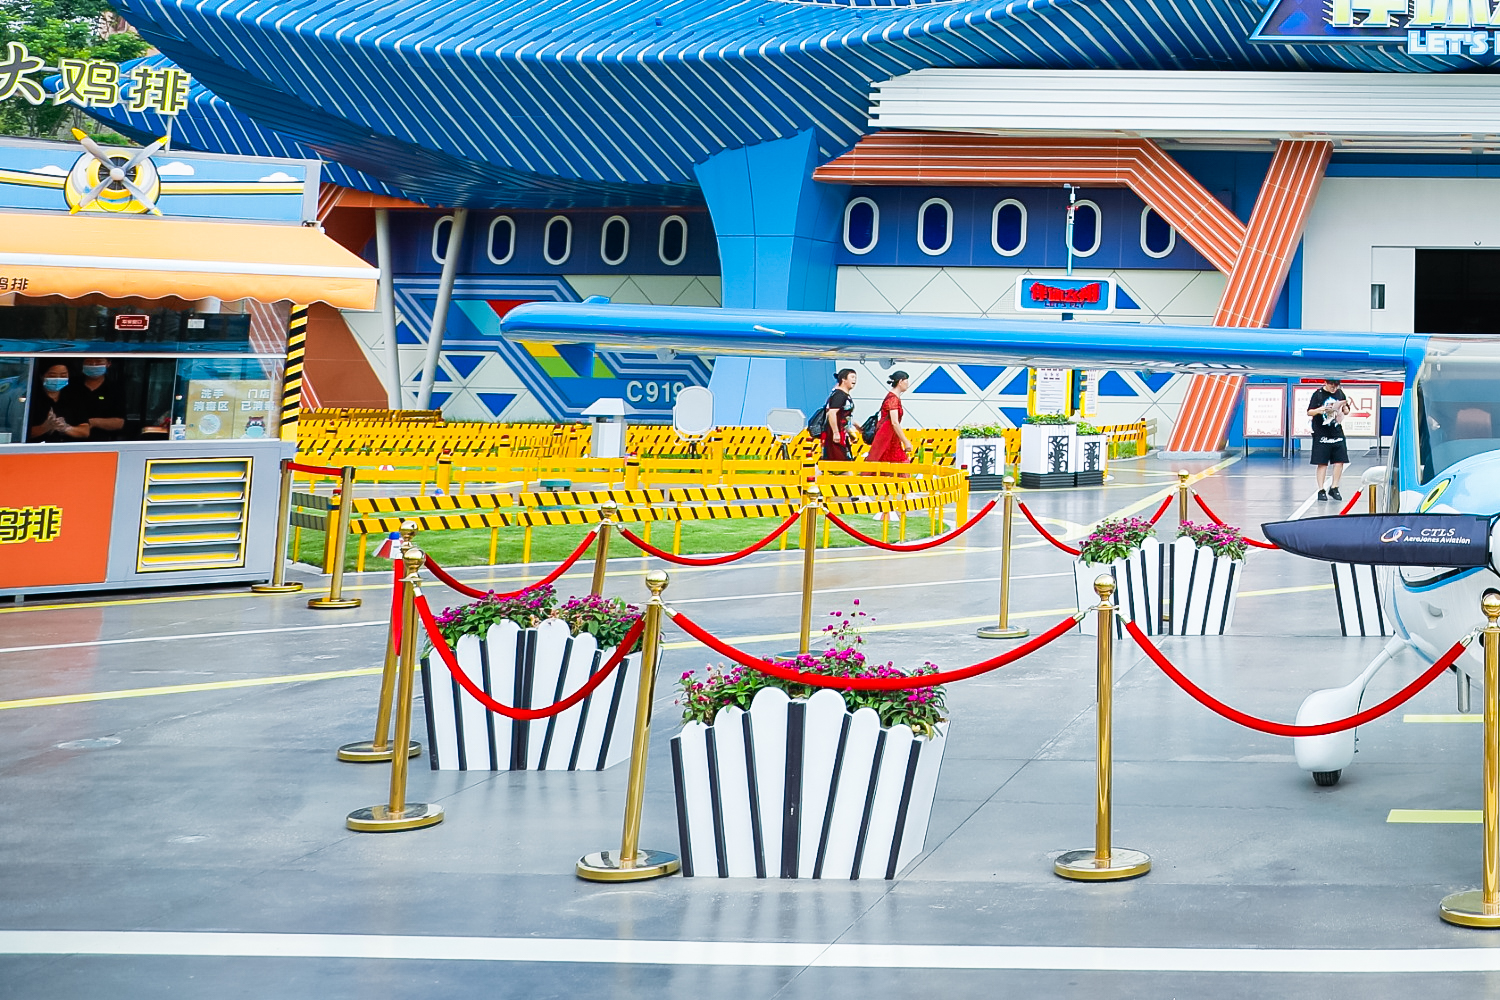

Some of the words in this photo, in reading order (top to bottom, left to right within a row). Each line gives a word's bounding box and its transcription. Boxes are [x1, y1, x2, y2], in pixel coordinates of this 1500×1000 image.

[1407, 31, 1490, 55] LET'S
[0, 42, 191, 115] 大鸡排
[201, 388, 224, 400] 洗手
[247, 388, 270, 400] 门店
[193, 400, 229, 412] 消毒区
[241, 400, 275, 412] 已消毒
[1348, 396, 1373, 411] 入口
[1420, 528, 1456, 537] CTLS
[1439, 536, 1471, 545] Aviation
